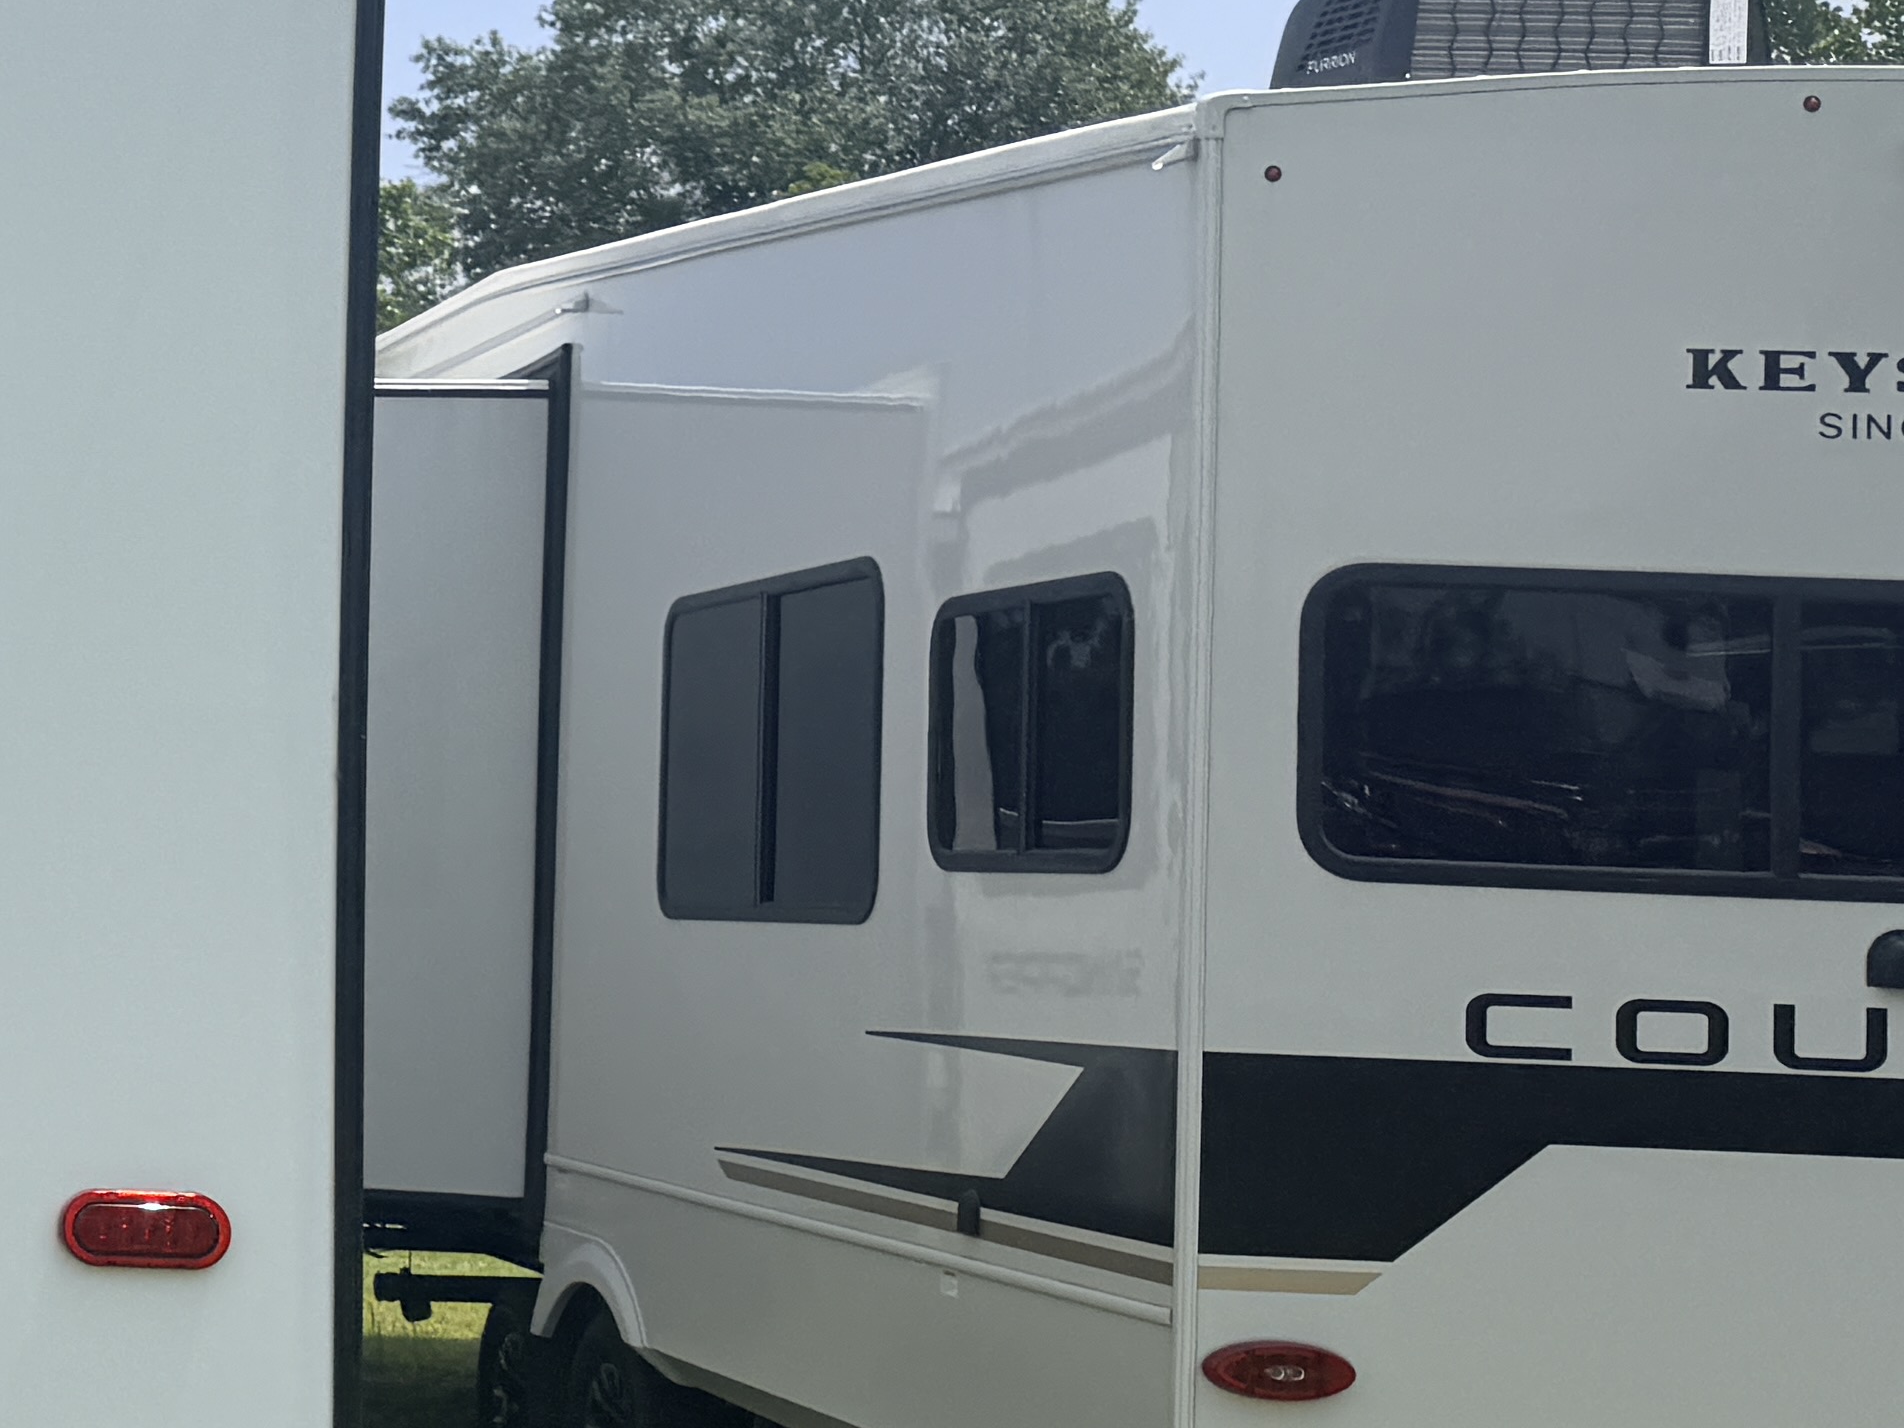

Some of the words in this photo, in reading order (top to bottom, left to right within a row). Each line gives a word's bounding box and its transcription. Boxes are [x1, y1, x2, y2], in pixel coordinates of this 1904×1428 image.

[1685, 348, 1904, 394] KEY
[1818, 412, 1904, 441] SIN
[1465, 992, 1889, 1073] COU
